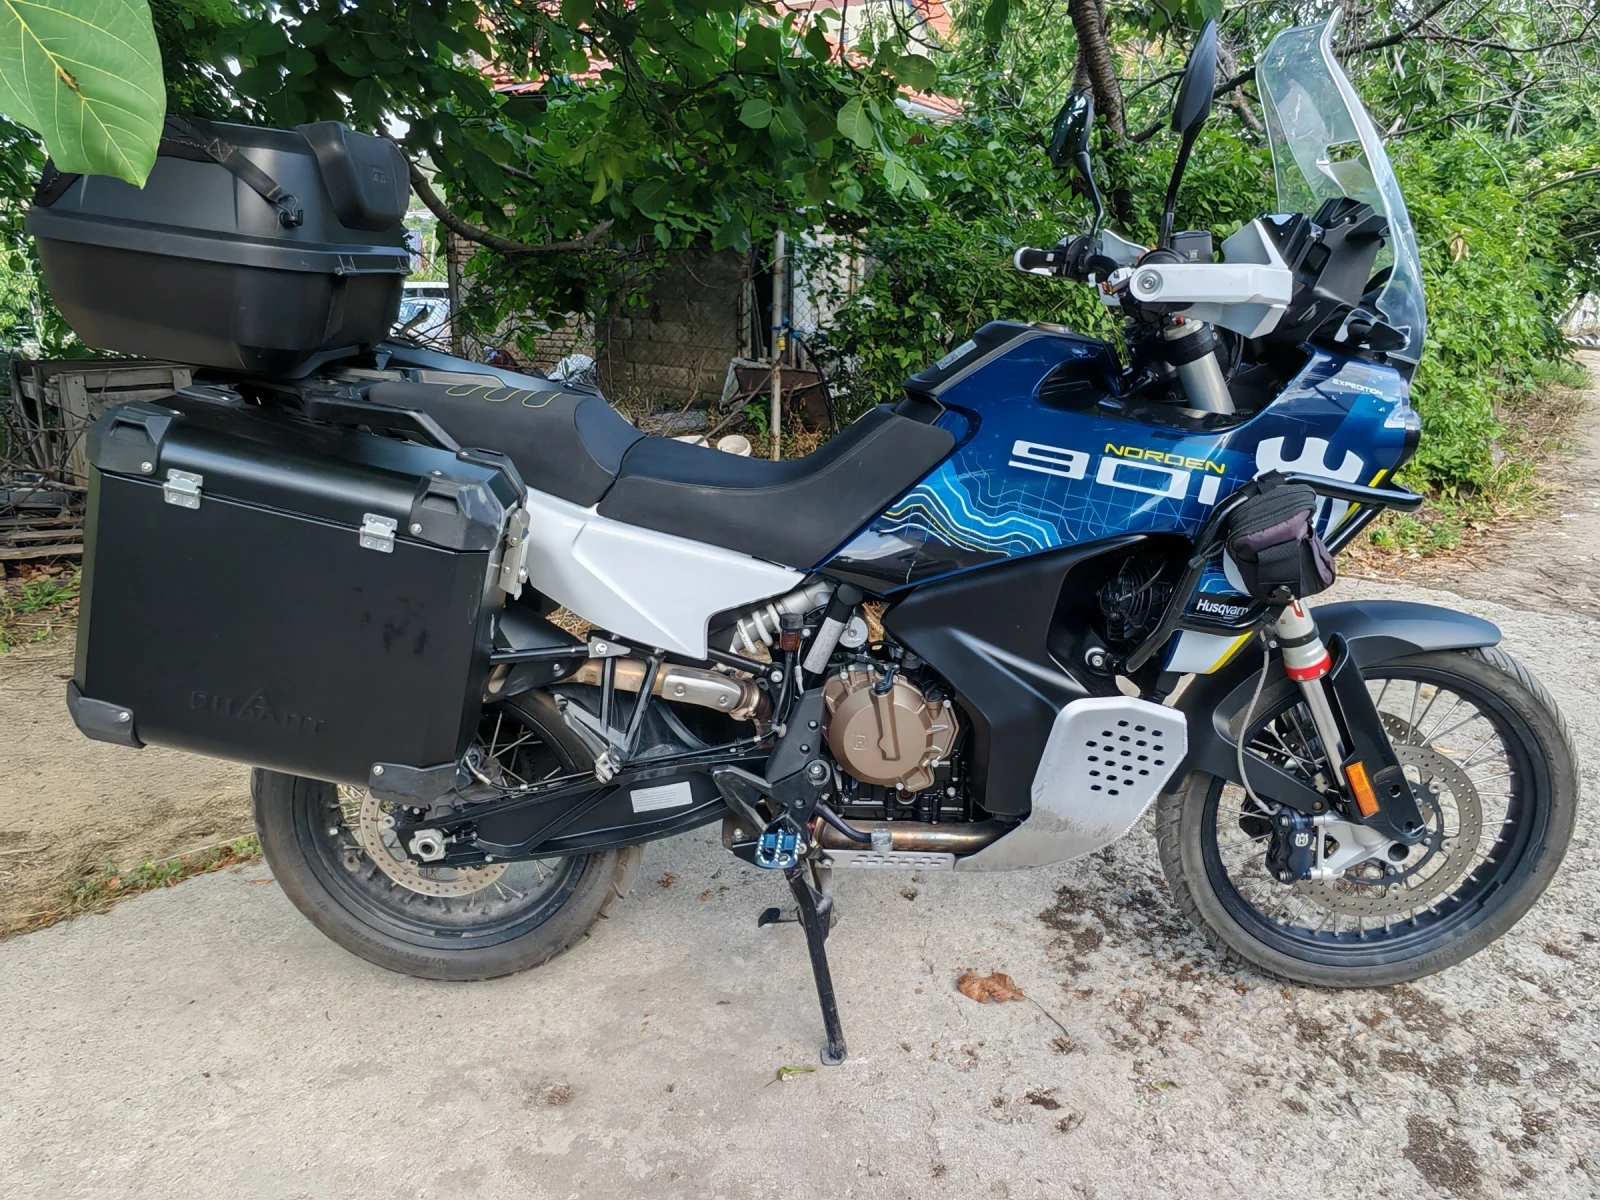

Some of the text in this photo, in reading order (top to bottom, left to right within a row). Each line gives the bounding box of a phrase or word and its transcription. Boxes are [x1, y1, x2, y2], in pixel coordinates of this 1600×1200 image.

[1332, 378, 1383, 396] EXPEDITION
[1008, 440, 1221, 505] 901
[1104, 443, 1225, 474] NORDEN
